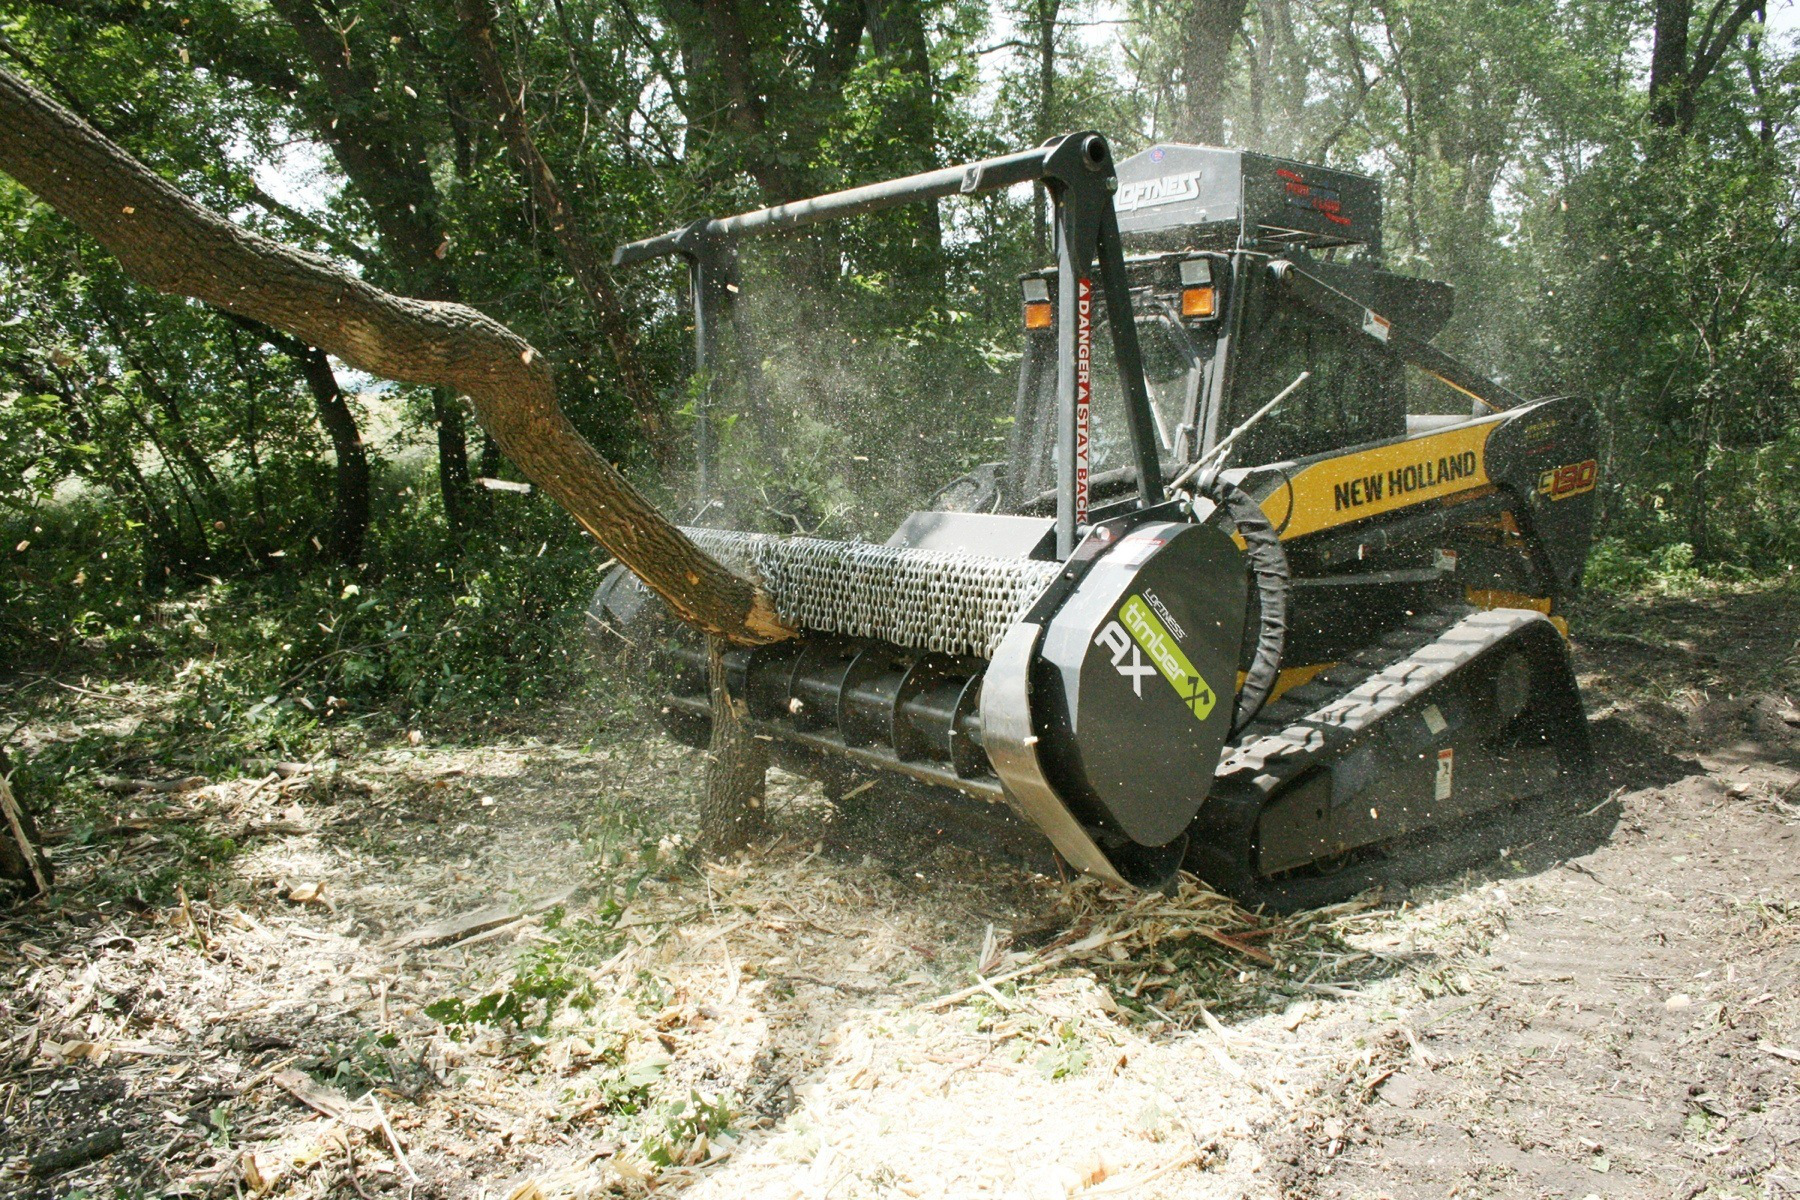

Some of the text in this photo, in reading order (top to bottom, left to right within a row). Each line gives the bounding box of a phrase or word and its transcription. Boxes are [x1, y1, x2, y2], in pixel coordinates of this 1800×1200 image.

[1076, 301, 1089, 523] DANGER STAY BACK
[1334, 450, 1477, 511] NEW HOLLAND
[1125, 602, 1186, 680] timber
[1142, 588, 1185, 642] LOFTNESS
[1094, 620, 1157, 700] AX
